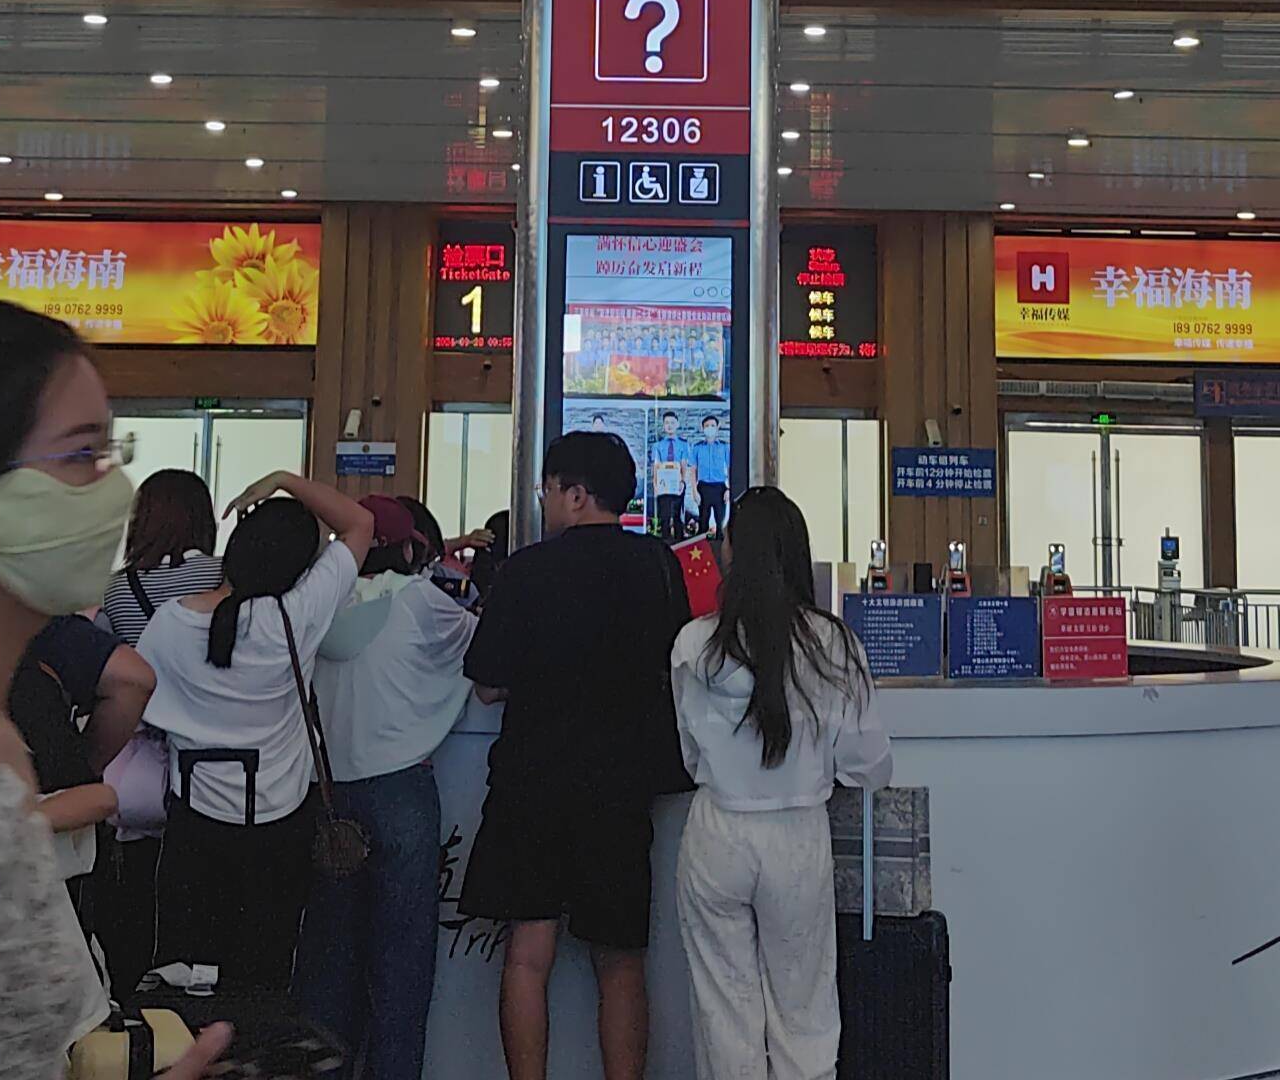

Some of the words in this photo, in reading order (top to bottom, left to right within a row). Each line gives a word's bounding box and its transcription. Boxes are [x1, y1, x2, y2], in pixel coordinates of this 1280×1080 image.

[601, 117, 701, 143] 12306
[1032, 264, 1054, 291] H
[1091, 266, 1252, 309] 幸福海南
[44, 304, 60, 314] 189
[65, 305, 91, 314] 0762
[96, 305, 123, 315] 9999
[462, 286, 482, 333] 1
[1020, 308, 1070, 321] 幸福传媒
[1173, 323, 1190, 334] 189
[1194, 324, 1220, 335] 0762
[1225, 324, 1253, 335] 9999
